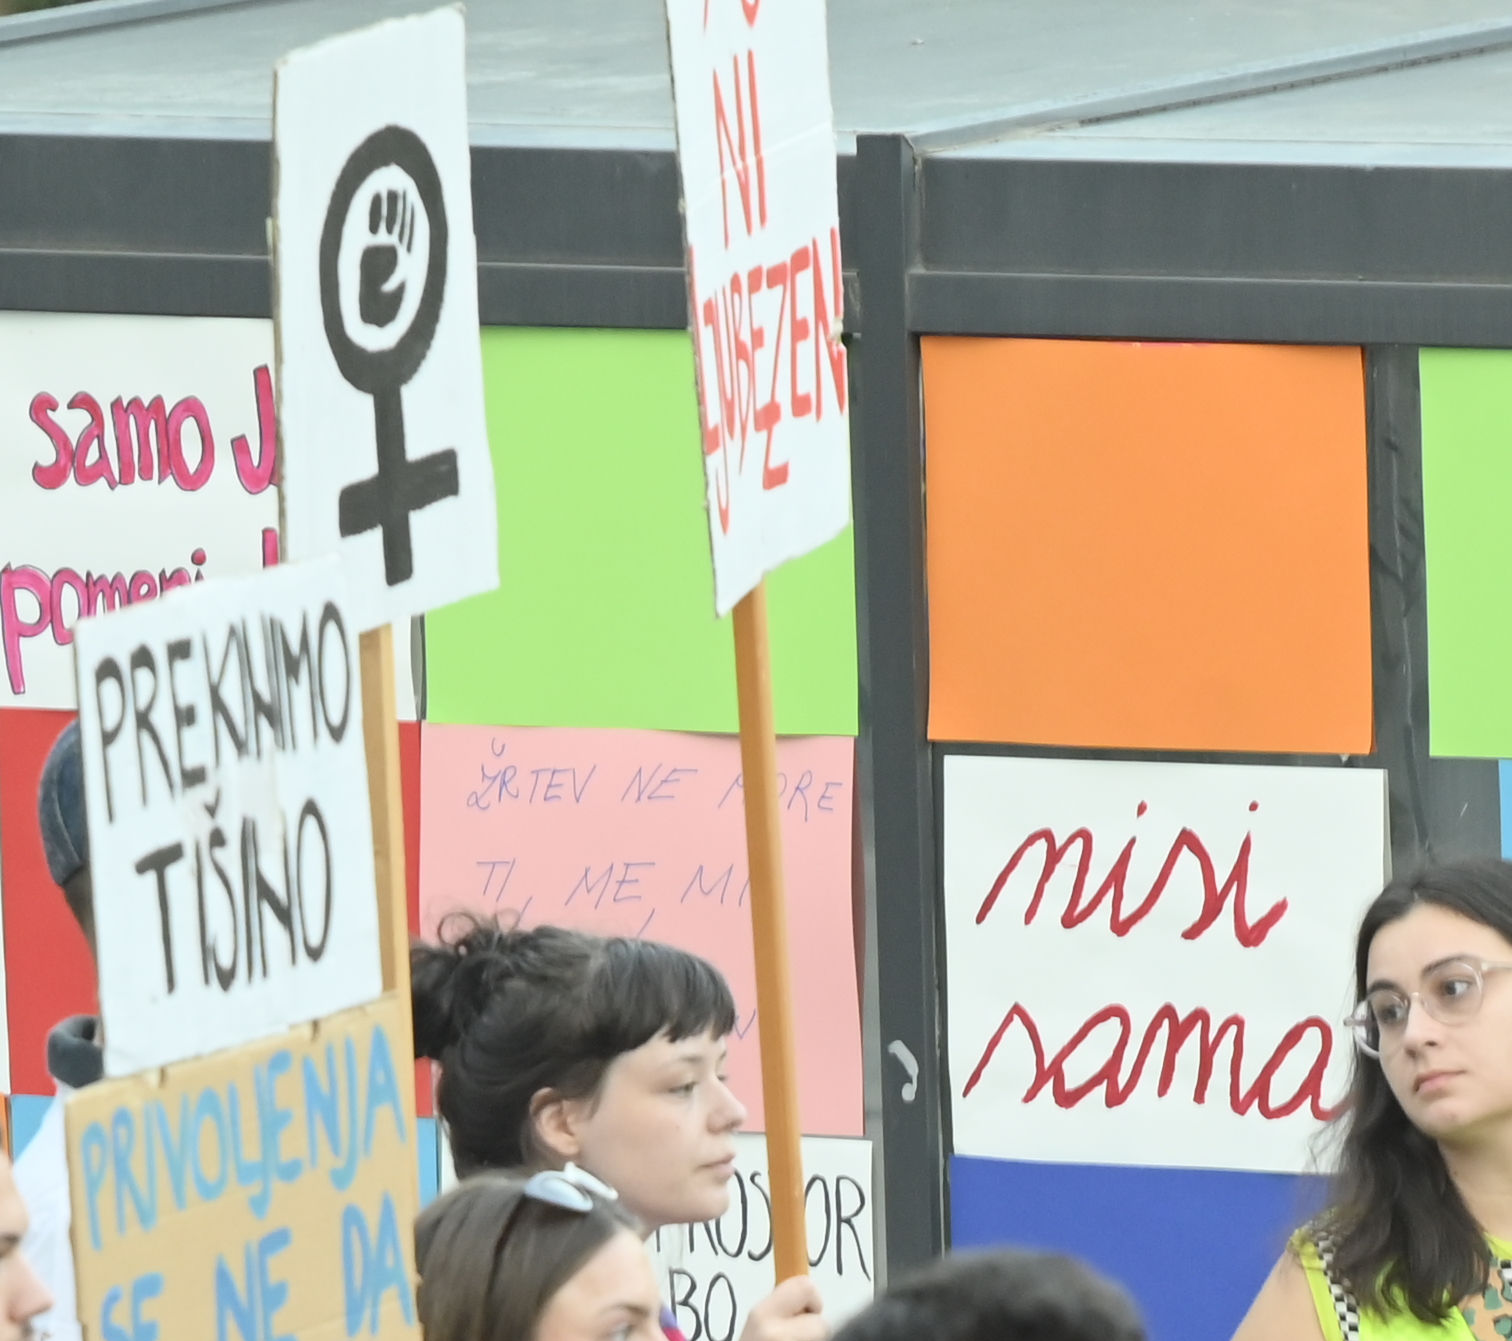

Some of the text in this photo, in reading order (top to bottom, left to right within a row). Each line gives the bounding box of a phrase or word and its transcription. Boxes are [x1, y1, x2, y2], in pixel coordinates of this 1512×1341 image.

[713, 49, 767, 250] NI
[29, 391, 215, 490] samo
[689, 226, 846, 535] LJUBEZEN
[94, 601, 351, 824] PREKINIMO
[621, 763, 698, 802] NE
[134, 789, 332, 994] TIŠINO
[975, 800, 1288, 948] nisi
[80, 1023, 407, 1252] PRIVOLJENJA
[961, 1001, 1354, 1122] sama
[341, 1191, 414, 1337] DA
